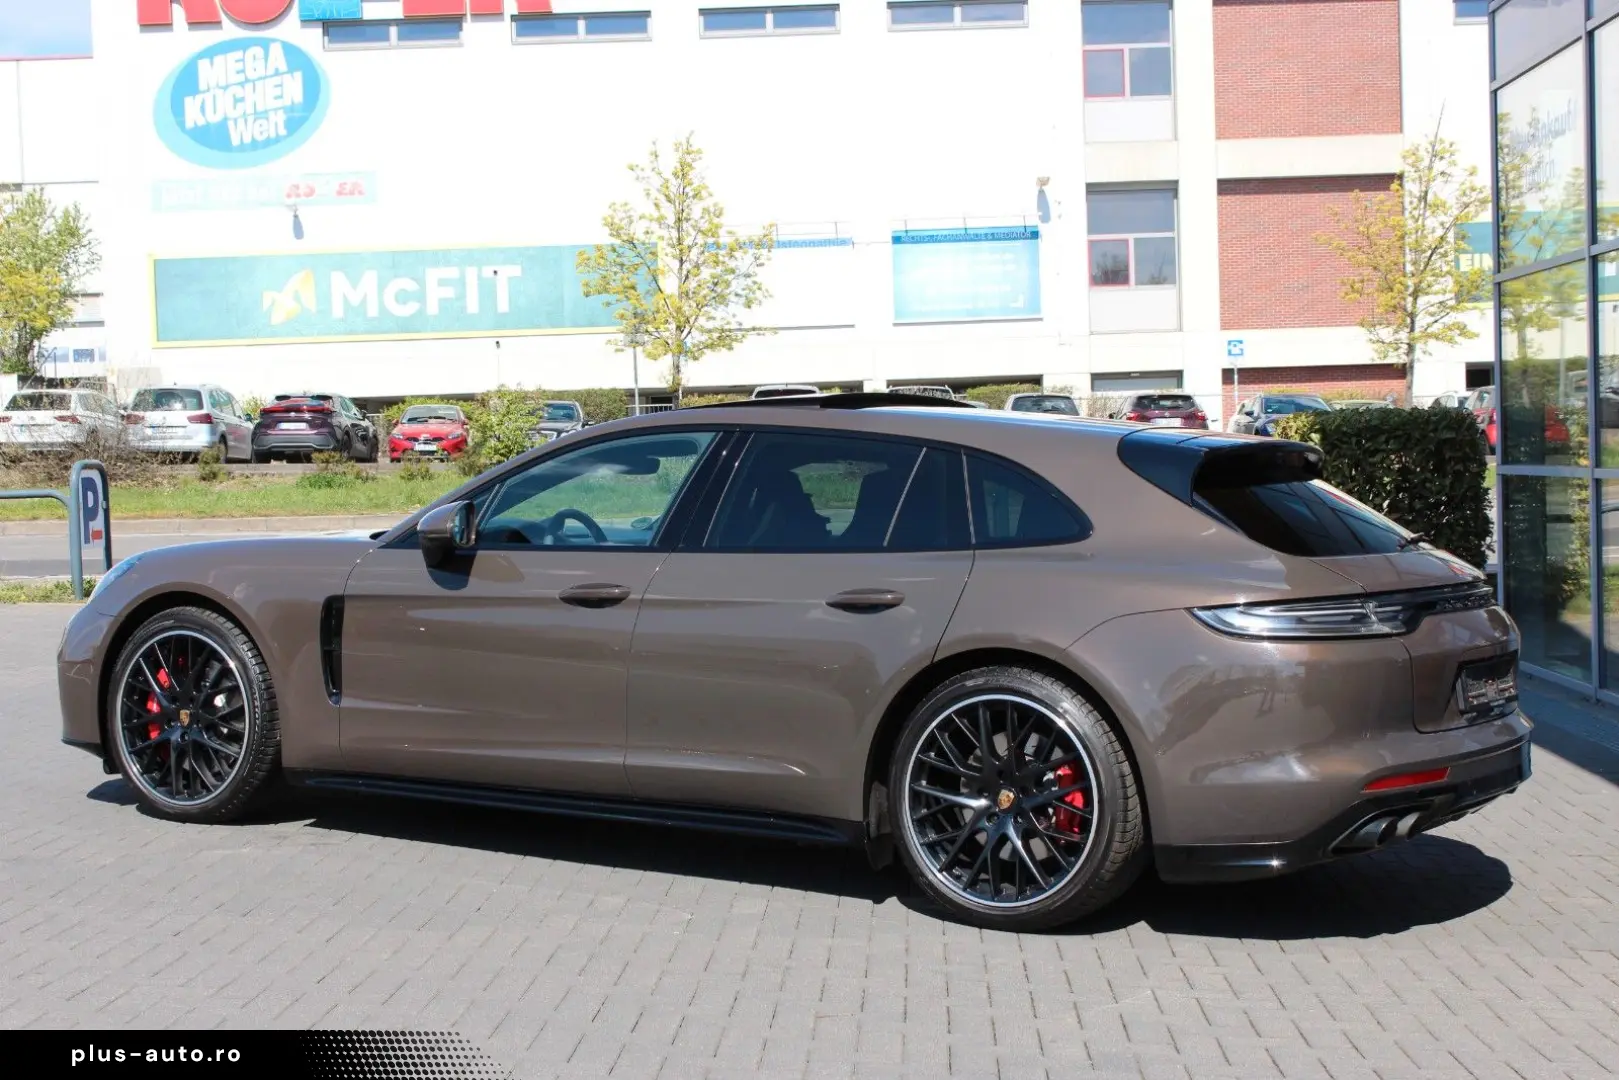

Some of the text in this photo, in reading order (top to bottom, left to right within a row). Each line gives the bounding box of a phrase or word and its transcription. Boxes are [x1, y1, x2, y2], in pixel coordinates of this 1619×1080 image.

[197, 41, 288, 92] MEGA
[227, 110, 287, 147] Welt
[994, 230, 1031, 240] MEDIATOR
[330, 264, 522, 319] McFIT
[81, 476, 100, 545] P
